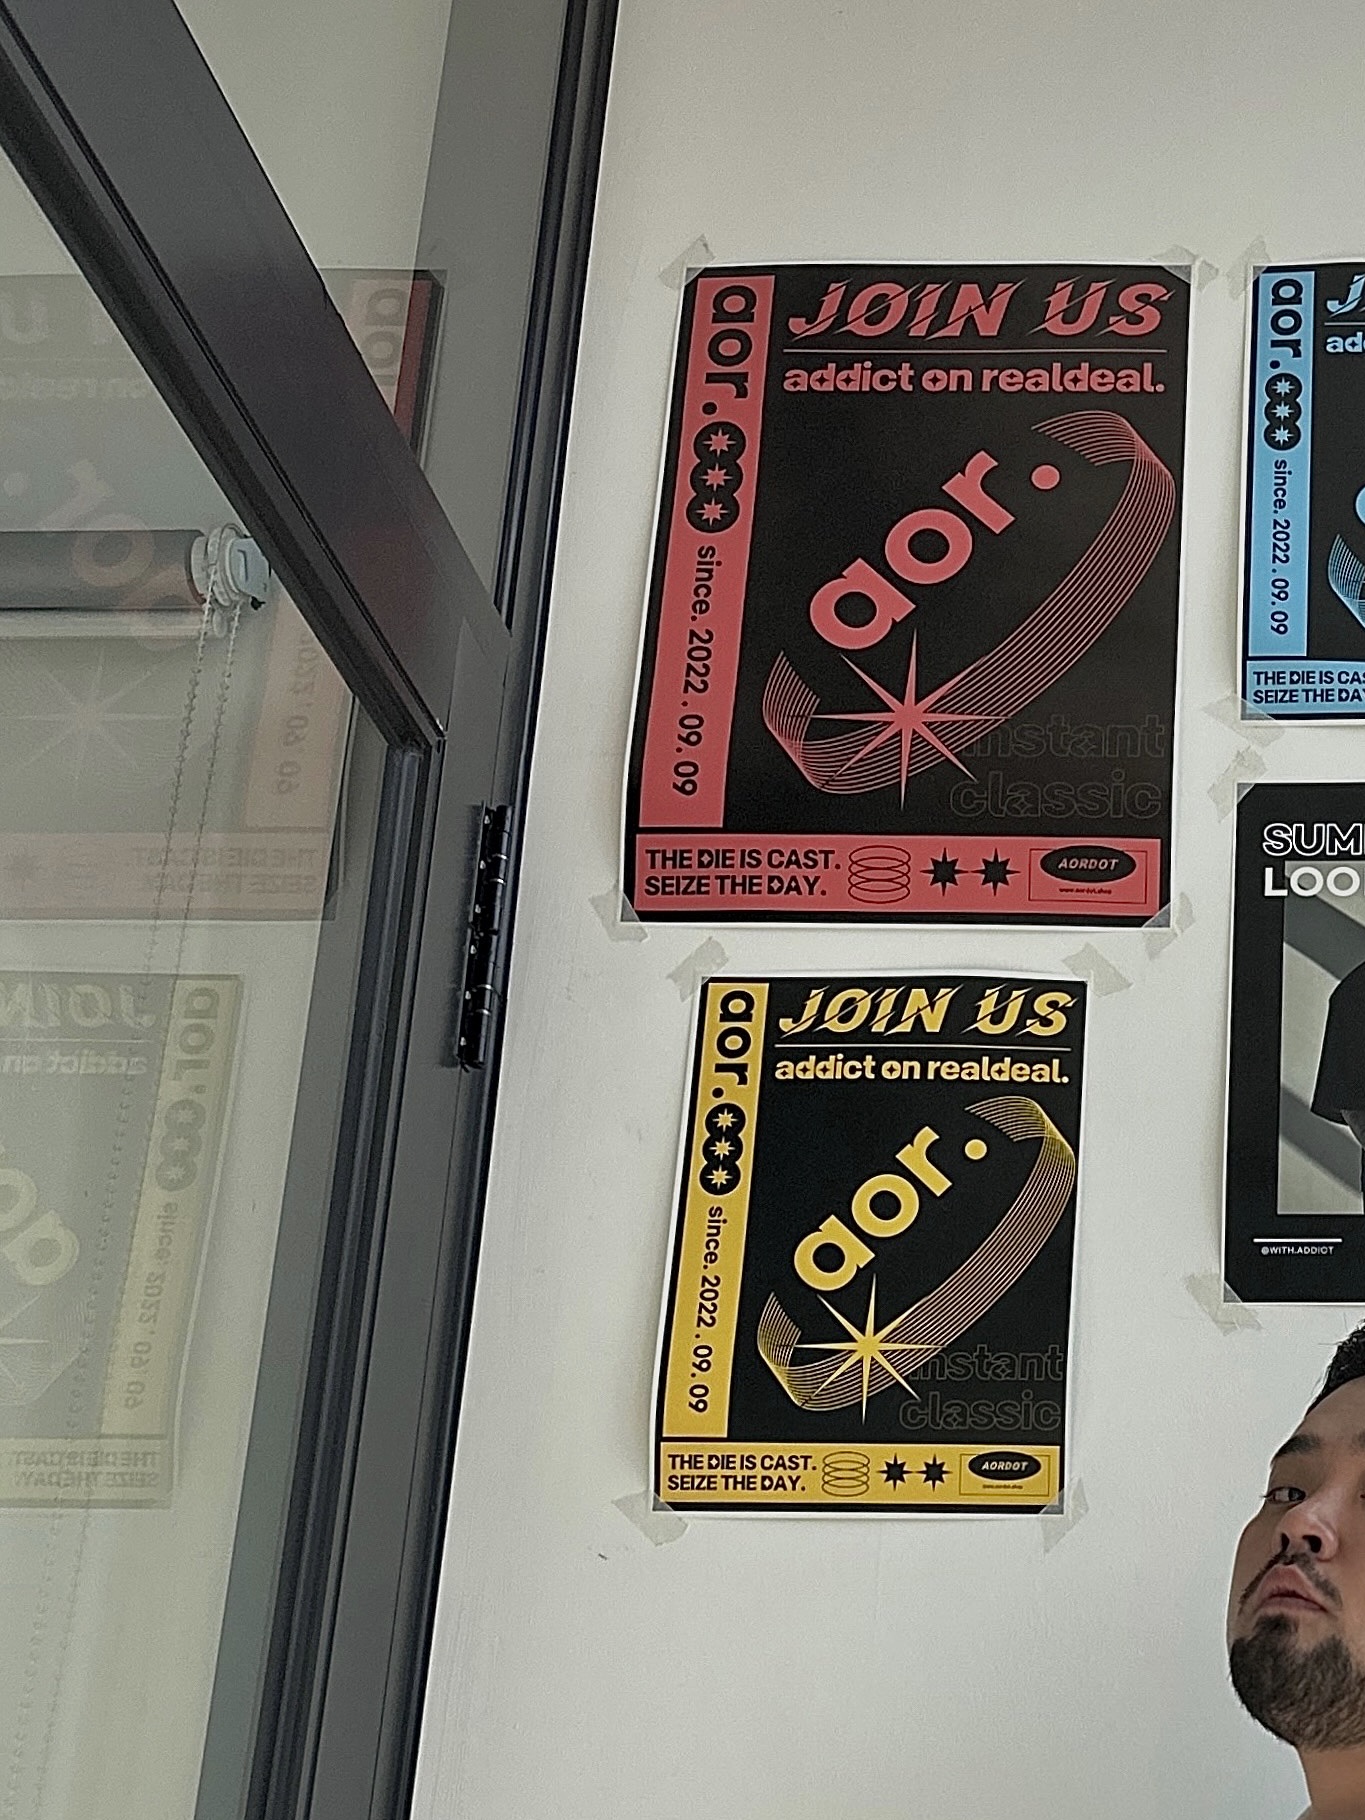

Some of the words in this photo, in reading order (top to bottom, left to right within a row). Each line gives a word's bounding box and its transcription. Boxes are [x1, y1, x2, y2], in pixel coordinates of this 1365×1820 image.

[787, 279, 1019, 340] JOIN
[1029, 279, 1173, 340] US
[784, 360, 913, 393] addict
[922, 367, 972, 392] on
[981, 360, 1165, 394] realdeal.
[1273, 459, 1292, 514] since.
[691, 545, 722, 621] since.
[1270, 610, 1289, 635] 09
[1253, 671, 1286, 685] THE
[1289, 671, 1316, 685] DIE
[1319, 671, 1334, 685] IS
[1253, 689, 1299, 704] SEIZE
[1301, 688, 1335, 703] THE
[962, 714, 1165, 758] nstant
[672, 761, 699, 796] 09
[950, 768, 1162, 819] classic
[645, 849, 693, 869] THE
[697, 849, 735, 869] DIE
[739, 849, 762, 869] IS
[767, 849, 841, 870] CAST.
[1057, 857, 1119, 871] AORDOT
[644, 875, 710, 896] SEIZE
[715, 875, 762, 896] THE
[767, 875, 827, 896] DAY.
[779, 983, 961, 1037] JOIN
[973, 983, 1077, 1037] US
[774, 1054, 875, 1080] addict
[881, 1060, 920, 1079] on
[927, 1057, 1069, 1083] realdeal.
[703, 1205, 727, 1270] since.
[909, 1344, 1064, 1381] nstant
[688, 1383, 709, 1413] 09
[900, 1389, 1061, 1430] classic
[667, 1454, 704, 1470] THE
[707, 1454, 736, 1470] DIE
[740, 1454, 757, 1470] IS
[760, 1454, 817, 1471] CAST.
[981, 1461, 1029, 1471] AORDOT
[667, 1475, 717, 1491] SEIZE
[720, 1475, 757, 1491] THE
[761, 1475, 806, 1491] DAY.
